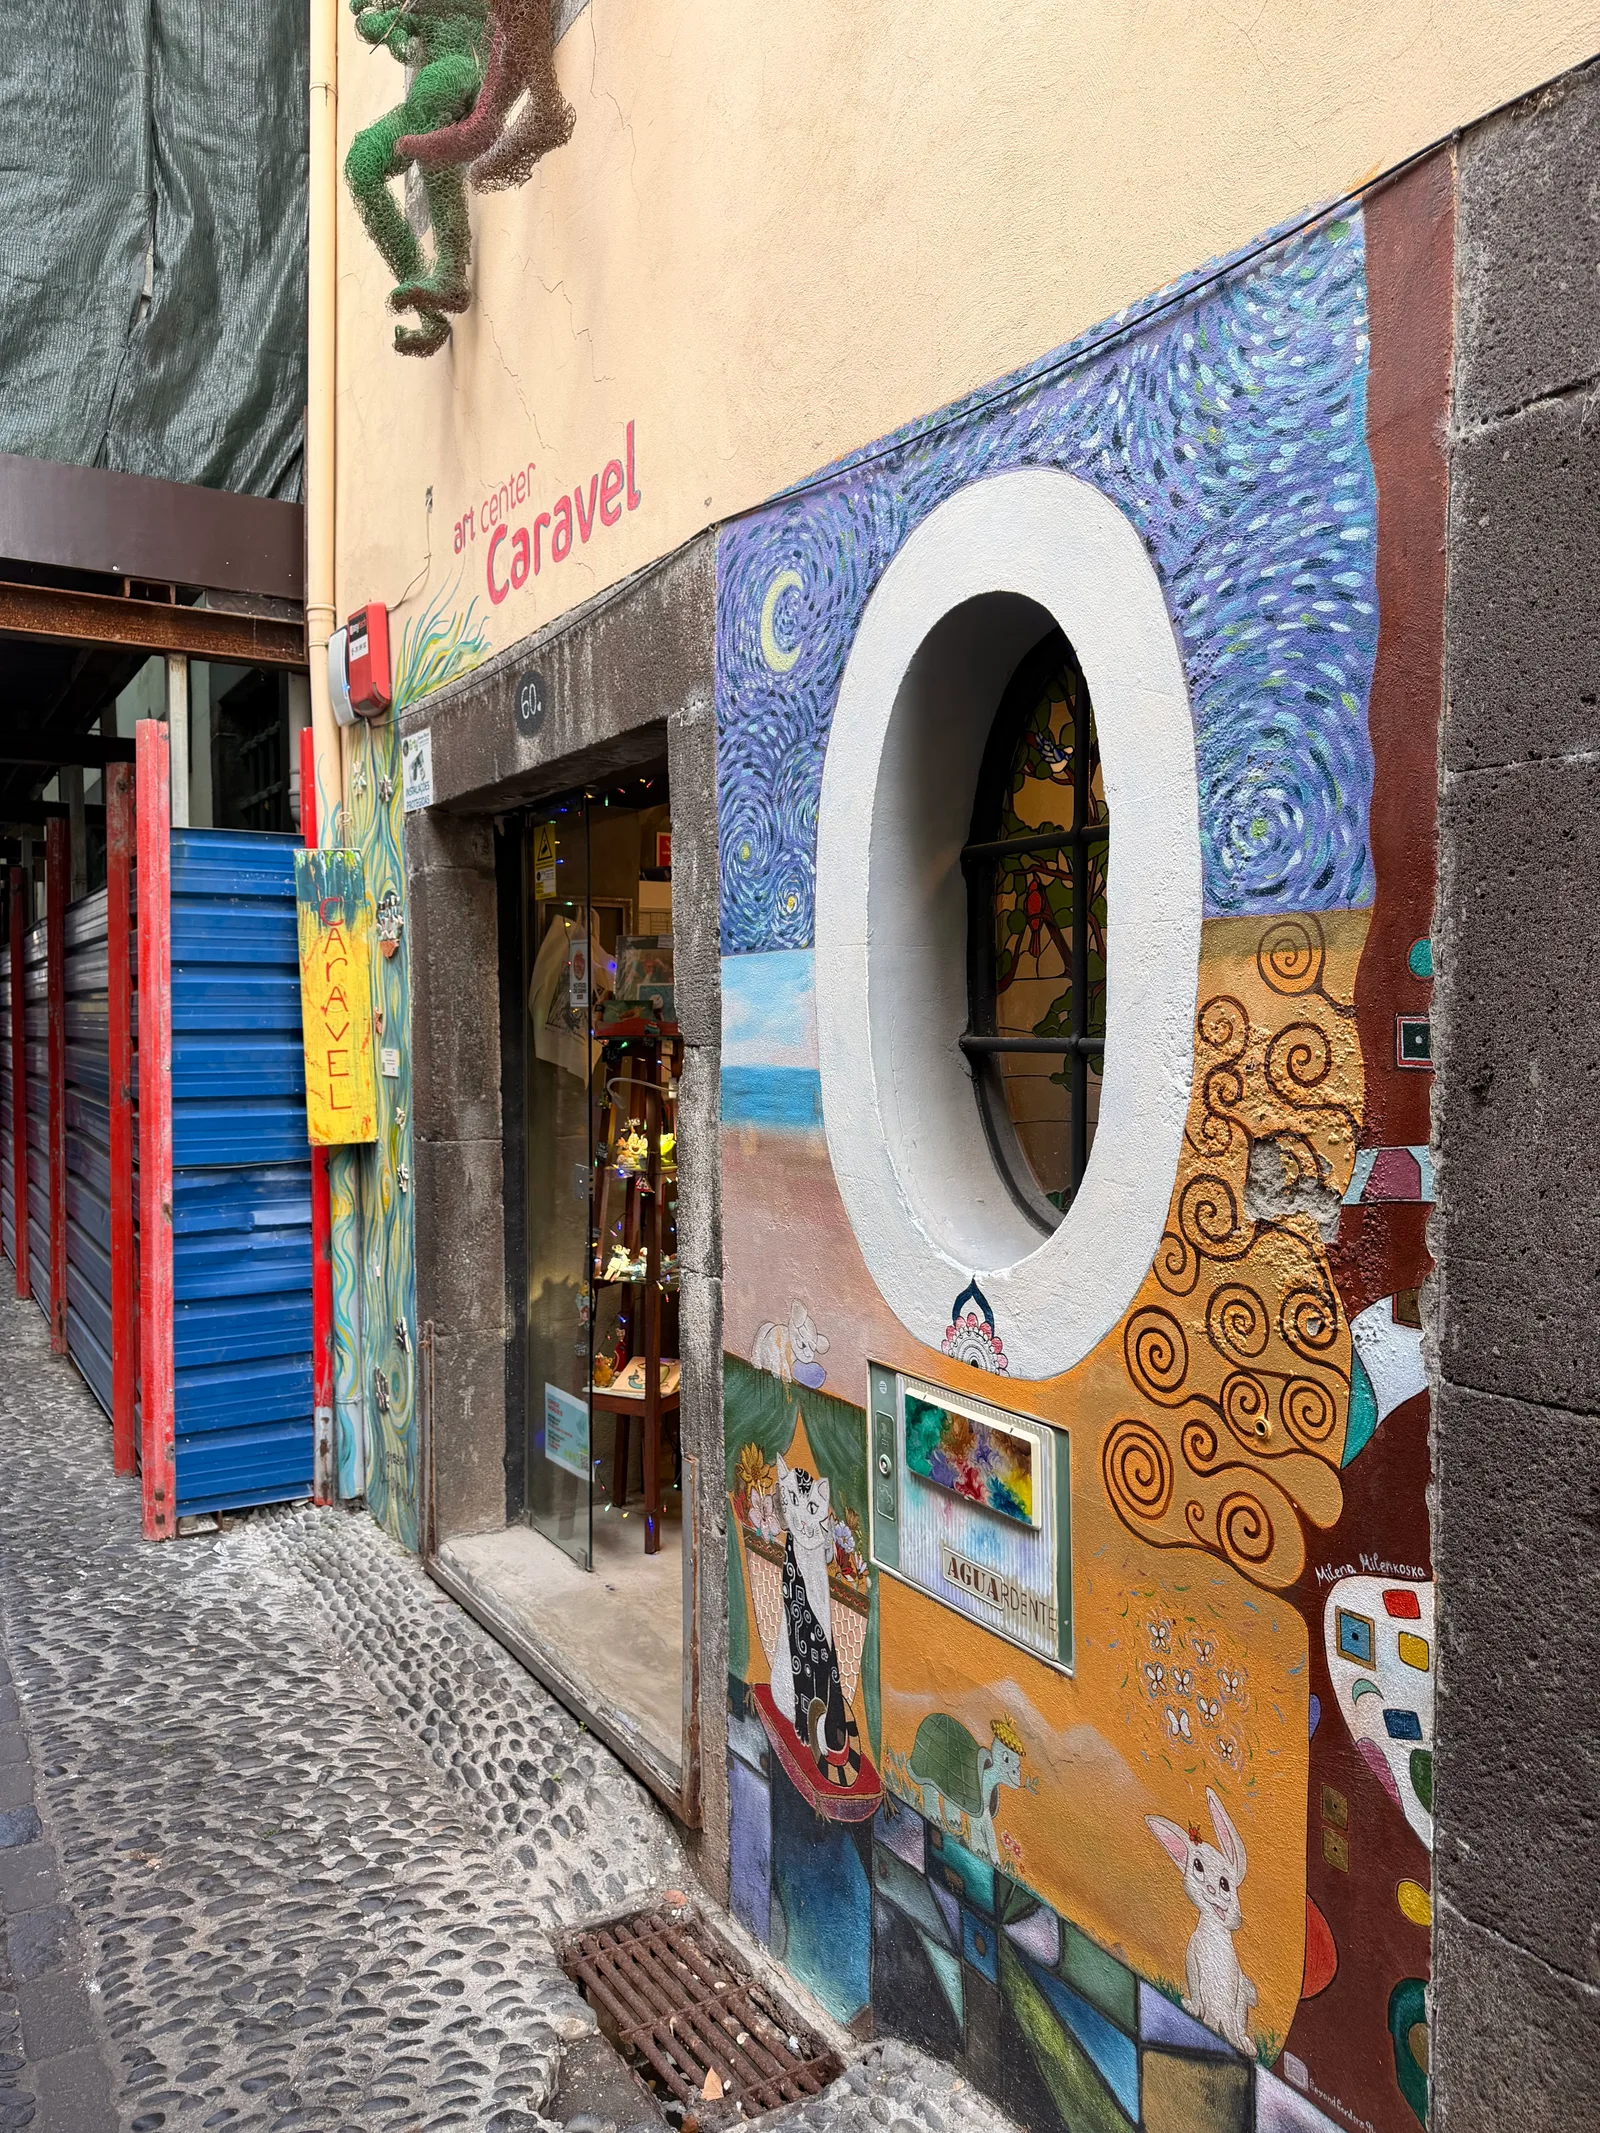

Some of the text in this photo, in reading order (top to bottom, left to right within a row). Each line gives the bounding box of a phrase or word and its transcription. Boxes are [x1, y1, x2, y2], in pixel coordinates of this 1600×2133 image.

[454, 462, 536, 554] art center
[487, 419, 641, 605] Caravel
[1315, 1563, 1356, 1587] Milena
